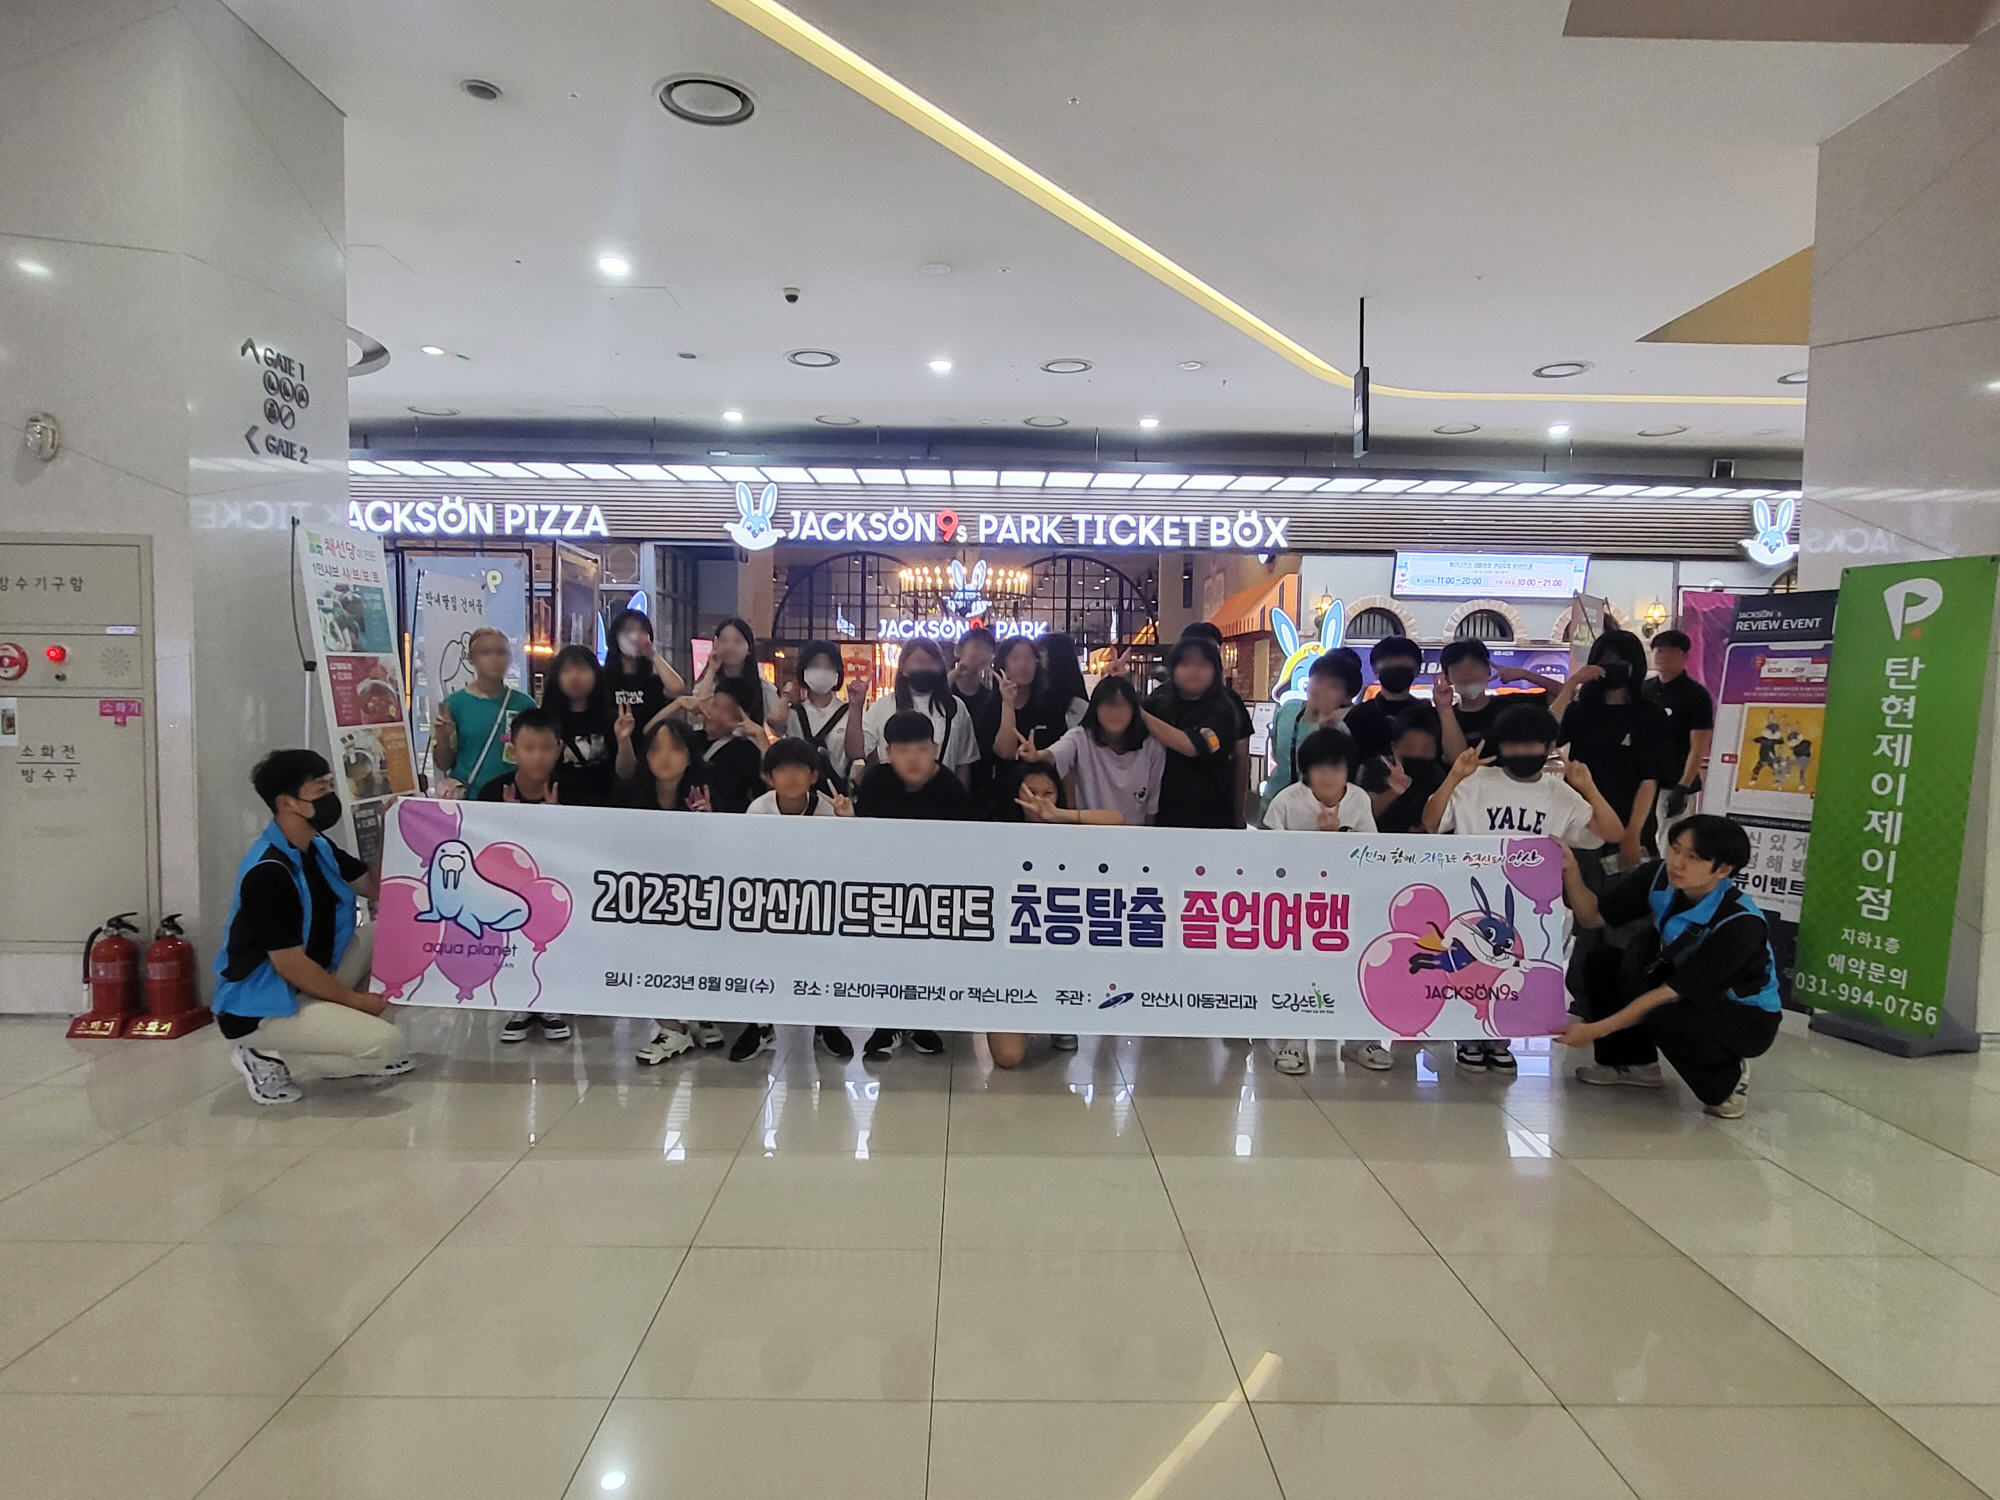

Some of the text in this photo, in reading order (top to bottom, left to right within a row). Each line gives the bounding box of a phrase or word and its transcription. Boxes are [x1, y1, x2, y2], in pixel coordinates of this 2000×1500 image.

[264, 347, 305, 382] GATE 1
[265, 434, 309, 464] GATE 2
[349, 495, 494, 536] ACKSON
[504, 503, 609, 537] PIZZA
[979, 513, 1064, 545] PARK
[1071, 513, 1204, 547] TICKET
[1210, 509, 1290, 548] BOX
[995, 621, 1048, 640] PARK
[1735, 617, 1822, 631] REVIEW EVENT
[102, 702, 139, 713] 소화기
[615, 696, 645, 705] DUCK
[21, 745, 75, 760] 소화전
[21, 768, 77, 783] 방수구
[1486, 806, 1546, 835] YALE
[1508, 850, 1545, 867] 안산
[592, 870, 994, 941] 2023년 안산시 드림스타트
[1010, 884, 1350, 951] 초등탈출 졸업여행
[423, 943, 518, 957] aqua planet
[1841, 928, 1900, 954] 지하1층
[1827, 953, 1908, 990] 예약문의
[604, 971, 632, 987] 일시
[644, 974, 695, 990] 2023년
[698, 976, 721, 991] 8월
[793, 980, 822, 996] 장소
[833, 982, 946, 1001] 일산아쿠아플라넷
[949, 989, 964, 1001] or
[967, 987, 1038, 1004] 잭슨나인스
[1055, 990, 1084, 1006] 주관
[1140, 992, 1184, 1008] 안산시
[1186, 993, 1258, 1010] 아동권리과
[1795, 972, 1938, 1025] 031-994-0756
[133, 1021, 172, 1033] 소화기
